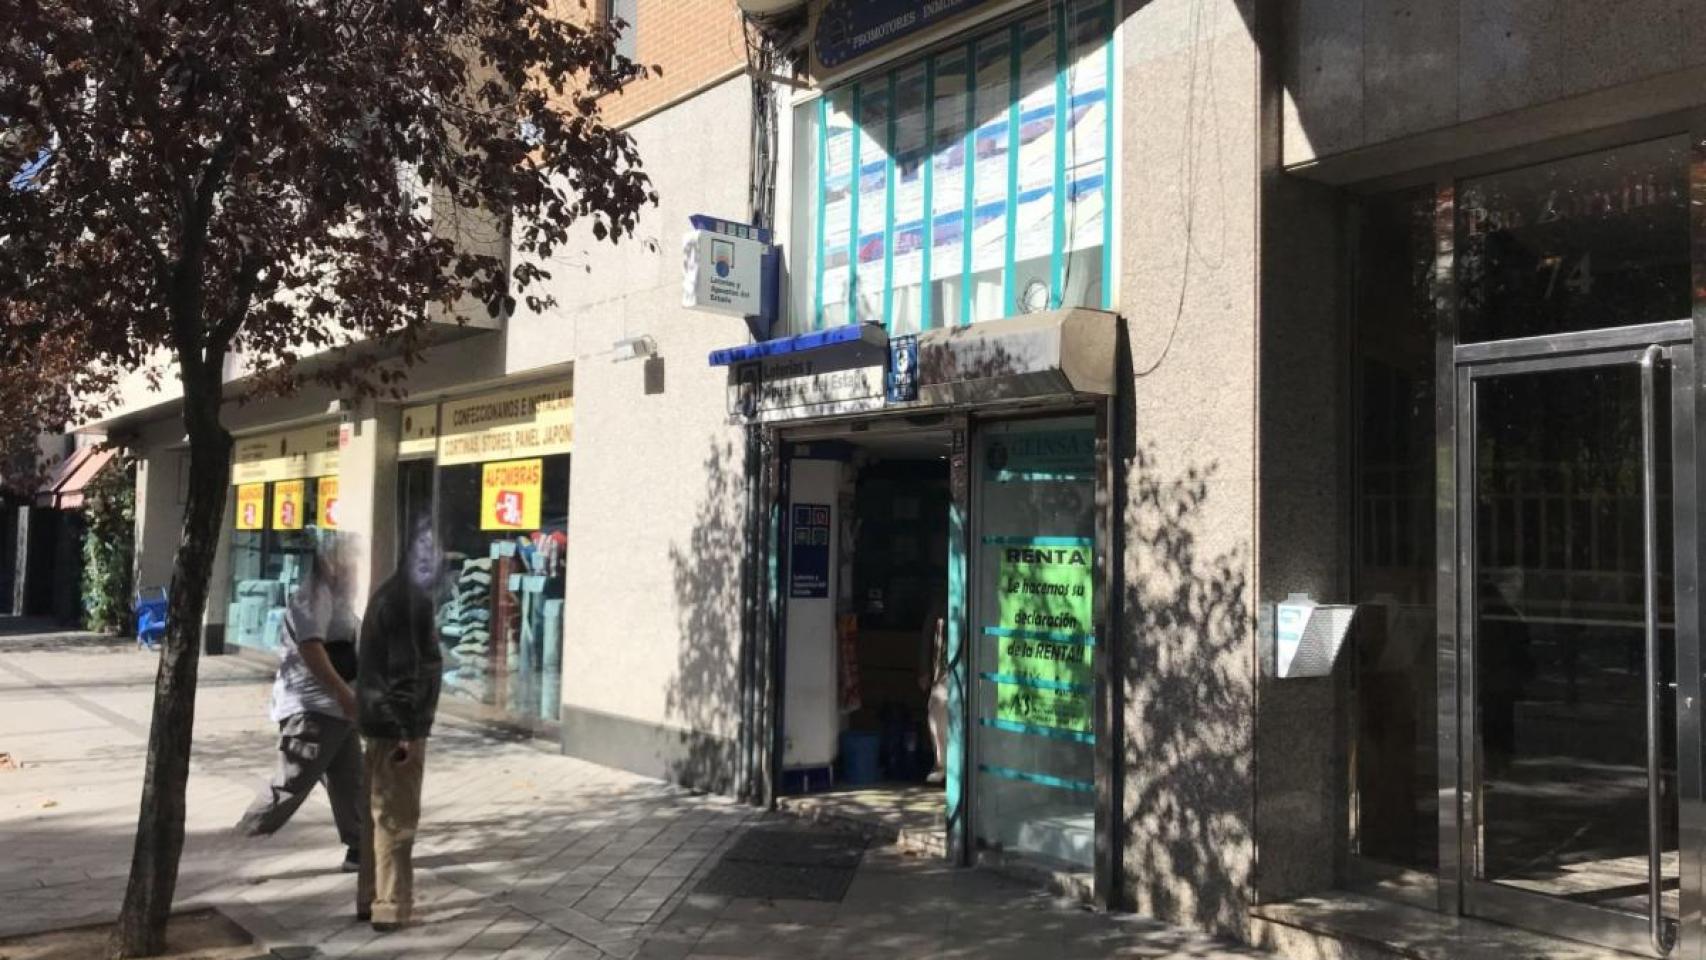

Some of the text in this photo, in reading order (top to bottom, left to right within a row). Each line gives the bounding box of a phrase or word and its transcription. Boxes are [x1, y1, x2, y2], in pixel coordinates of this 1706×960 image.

[852, 10, 917, 49] PROMOTORES
[453, 398, 519, 427] CONFECCIONAMOS
[521, 397, 528, 416] E
[515, 428, 540, 449] PANEL
[486, 464, 541, 487] ALFOMBRAS
[1005, 548, 1087, 566] RENTA
[1007, 577, 1085, 597] Le hacemos su
[1014, 609, 1077, 629] declaración
[1007, 640, 1021, 657] de
[1022, 641, 1034, 658] la
